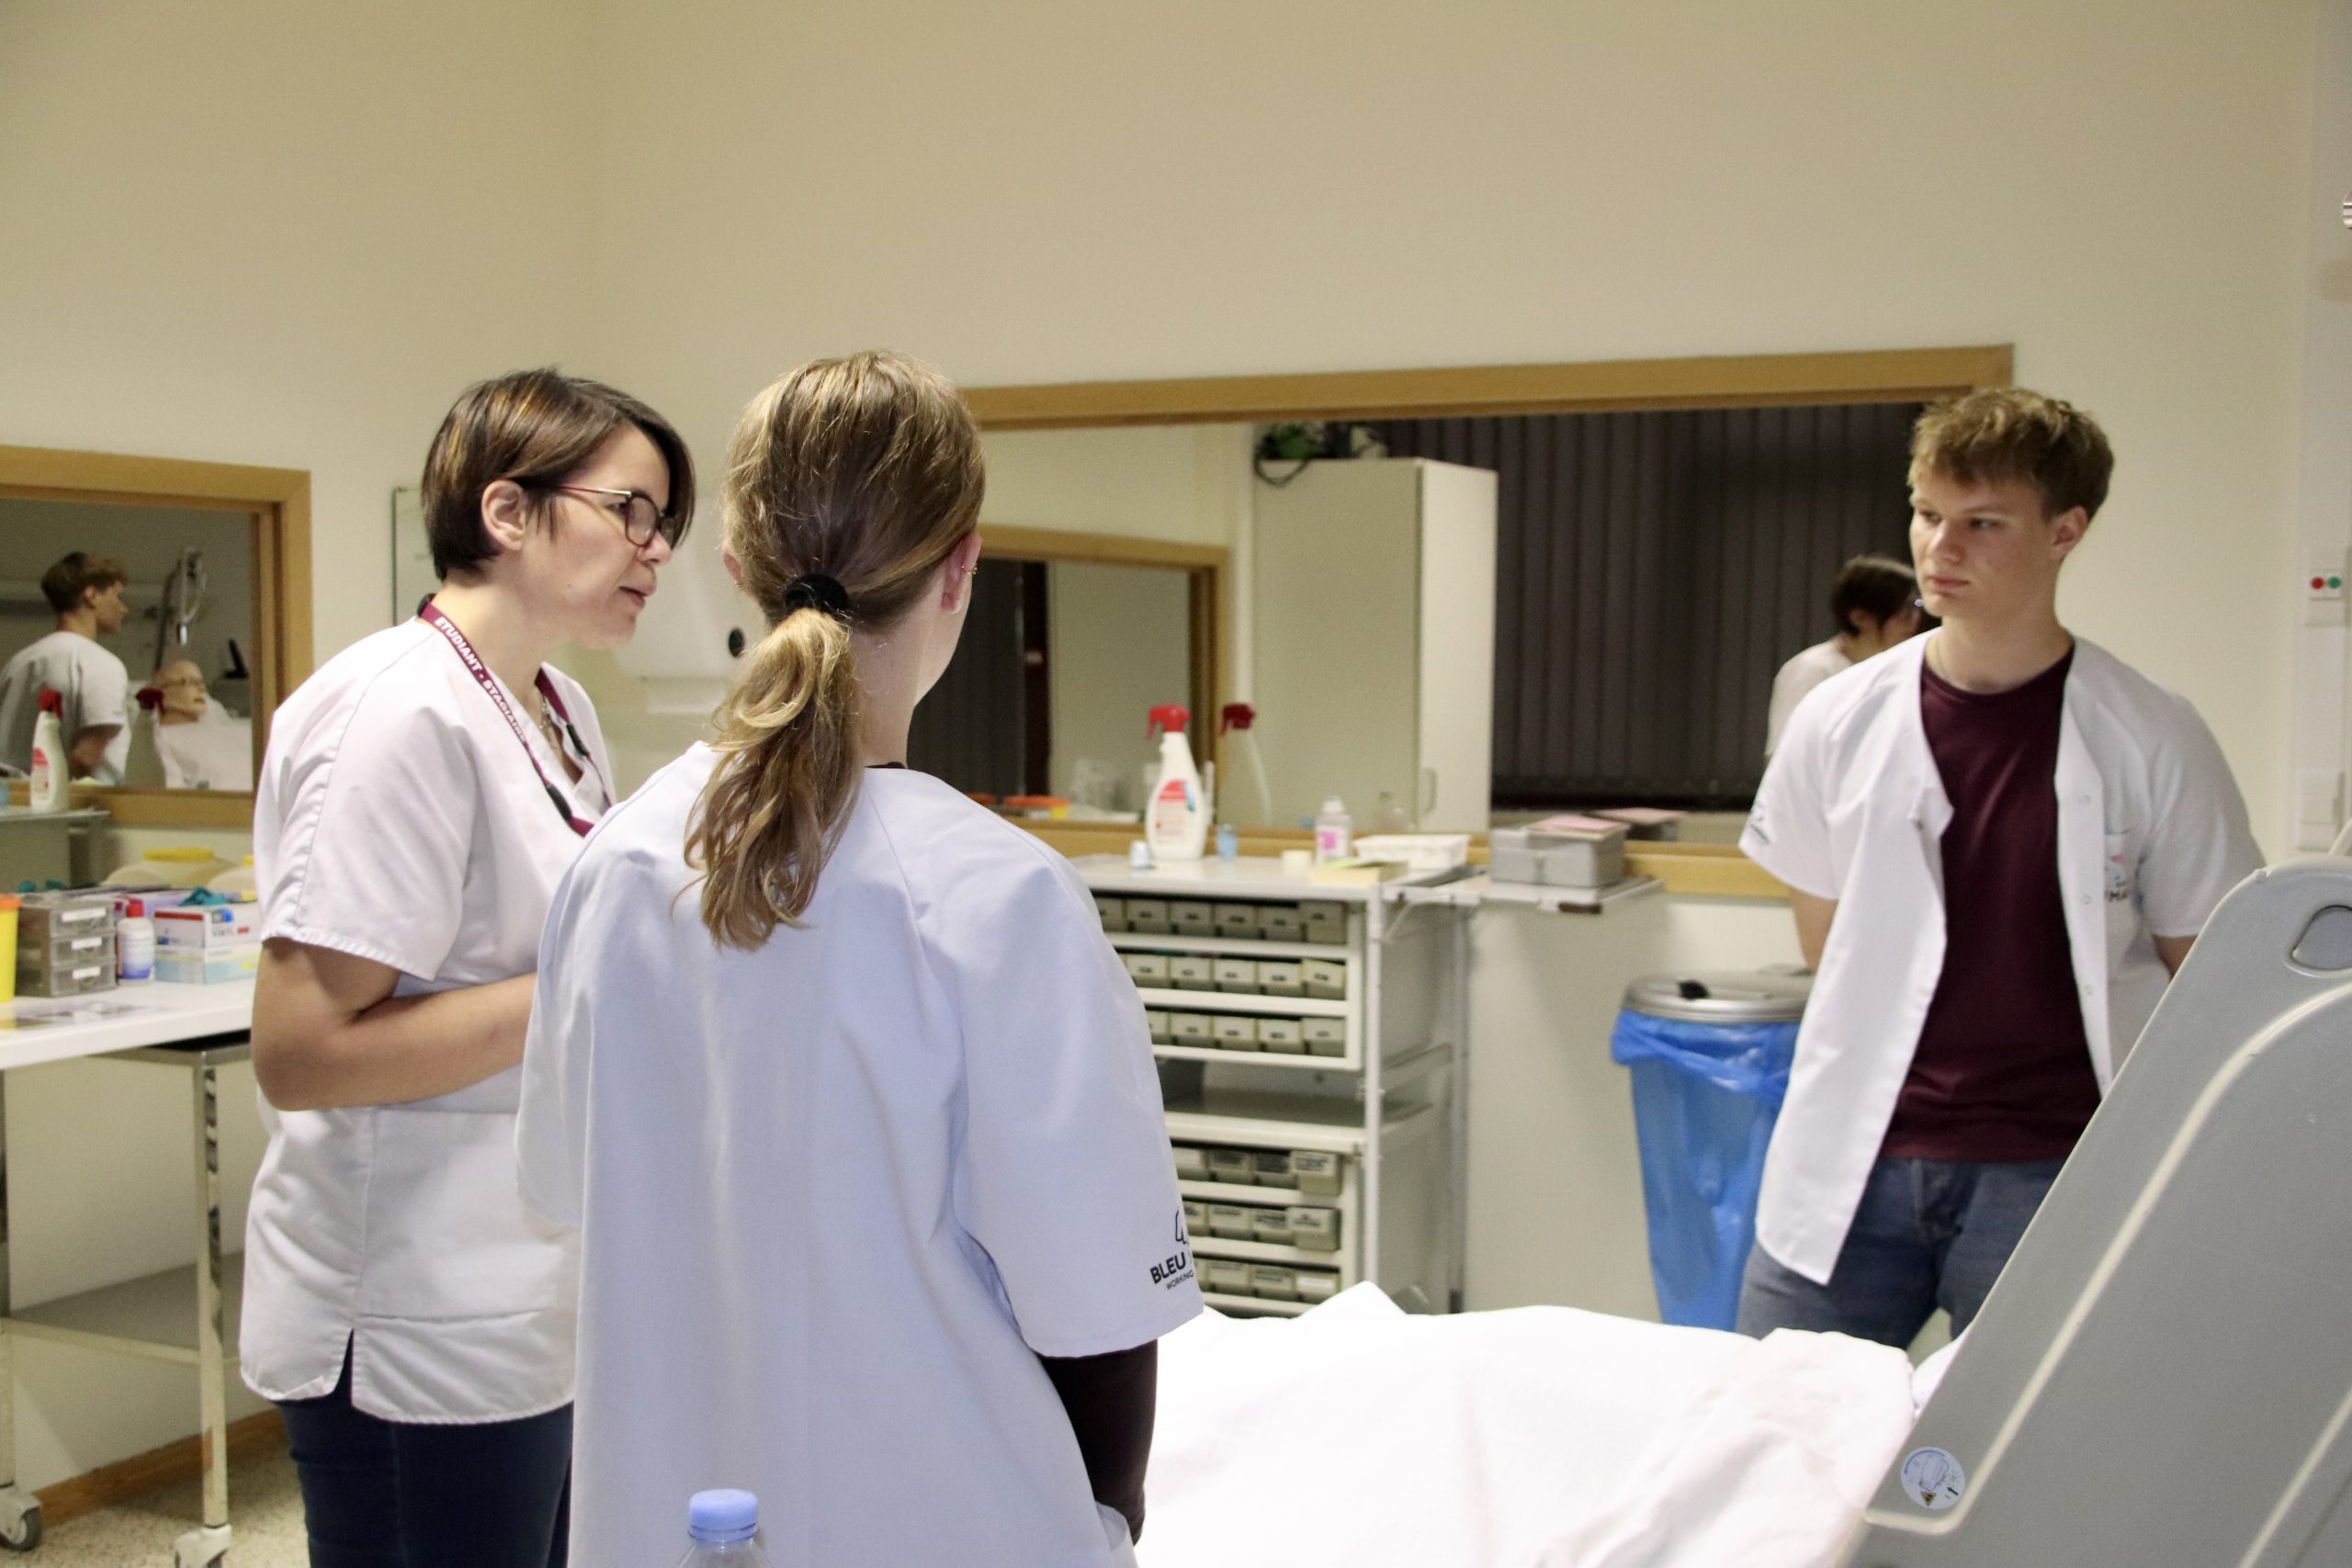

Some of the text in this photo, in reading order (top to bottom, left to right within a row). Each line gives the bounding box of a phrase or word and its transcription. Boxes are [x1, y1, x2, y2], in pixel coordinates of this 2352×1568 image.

[435, 616, 483, 671] ETUDIANT
[1150, 1252, 1186, 1284] BLEU
[1166, 1269, 1194, 1290] WORKING
